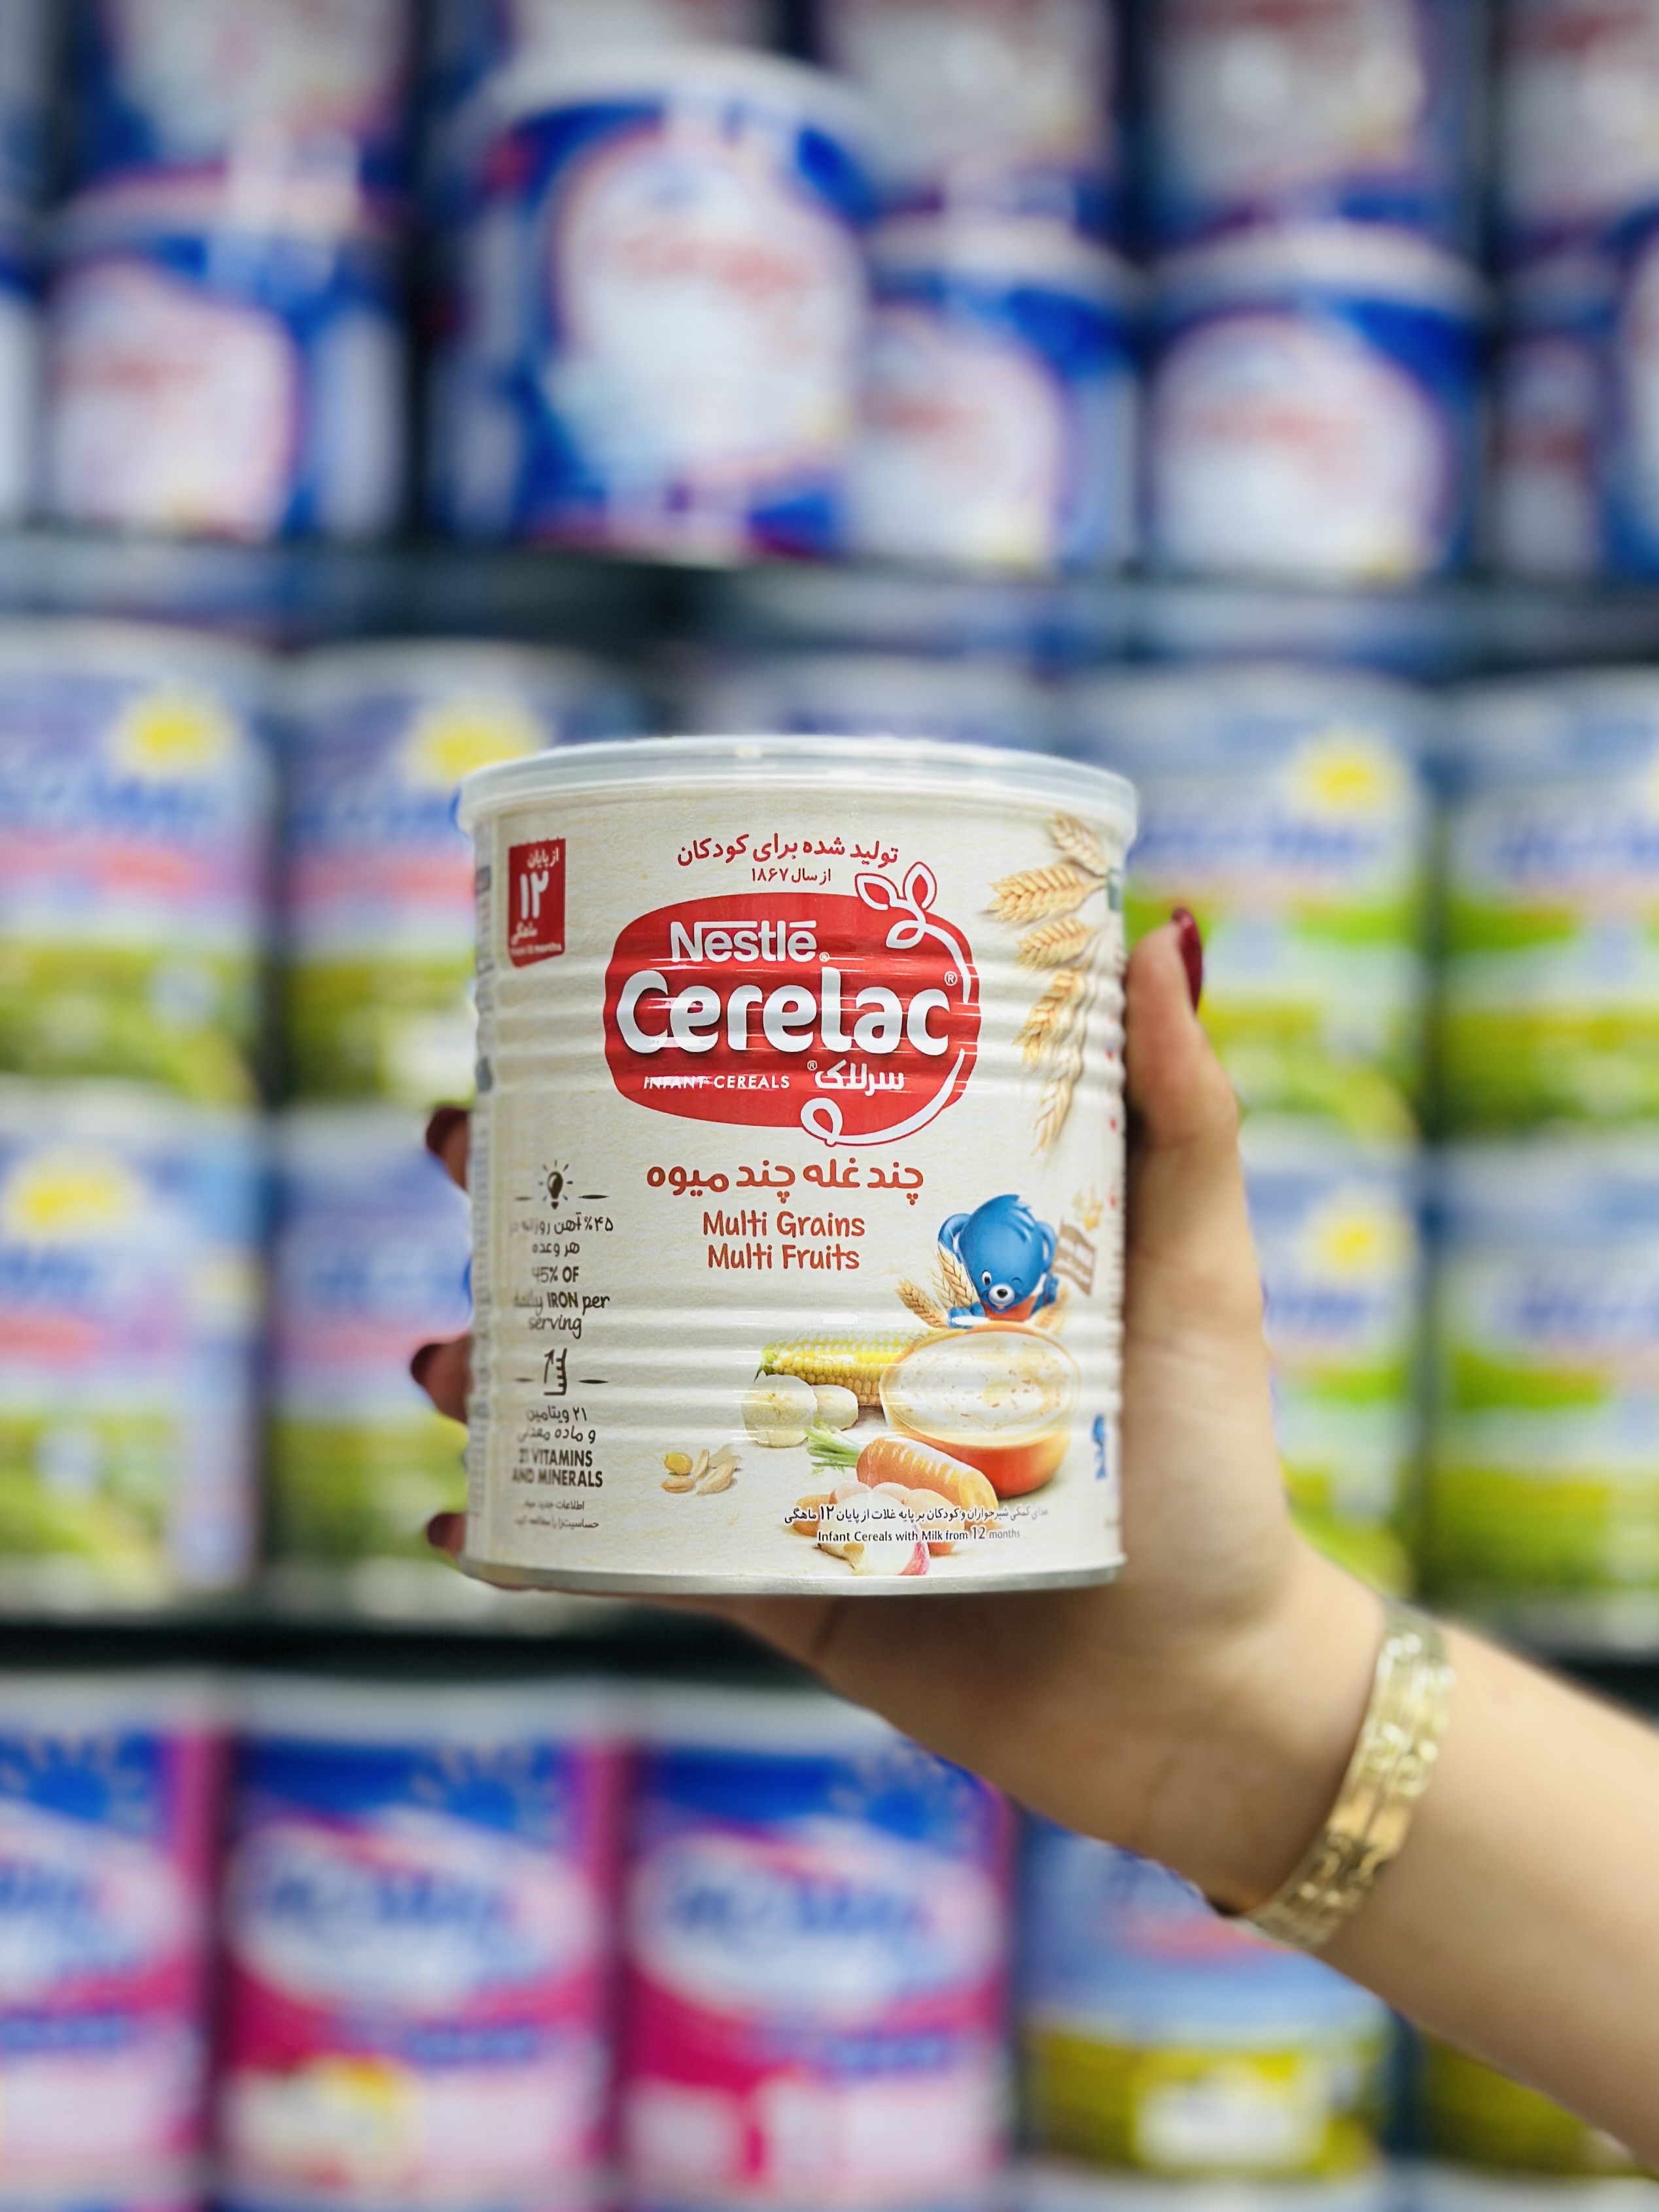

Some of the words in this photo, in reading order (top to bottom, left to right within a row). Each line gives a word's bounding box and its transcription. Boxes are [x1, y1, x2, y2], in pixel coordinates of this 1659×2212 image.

[678, 834, 750, 866] کودکان
[753, 833, 798, 862] برای
[803, 837, 845, 855] شده
[850, 841, 899, 868] تولید
[752, 868, 789, 883] ۱۸۶۷
[792, 868, 818, 883] سال
[819, 868, 831, 885] از
[519, 870, 550, 920] ۱۲
[616, 966, 951, 1056] Cerelac
[643, 1076, 707, 1089] INFANT
[713, 1075, 790, 1089] CEREALS
[646, 1166, 729, 1196] میوه
[736, 1160, 796, 1203] چند
[803, 1157, 860, 1189] غله
[867, 1161, 924, 1205] چند
[554, 1212, 582, 1235] آهن
[703, 1210, 767, 1237] Multi
[777, 1210, 865, 1238] Grains
[532, 1243, 561, 1257] وعده
[564, 1242, 580, 1257] هر
[708, 1242, 772, 1270] Multi
[782, 1243, 860, 1271] Fruits
[562, 1265, 580, 1283] OF
[547, 1291, 579, 1308] IRON
[582, 1294, 610, 1316] per
[527, 1314, 582, 1340] serving
[554, 1424, 584, 1442] ماده
[588, 1429, 596, 1445] و
[531, 1448, 593, 1467] VITAMINS
[512, 1467, 535, 1484] AND
[537, 1468, 603, 1488] MINERALS
[784, 1507, 816, 1524] ماهگی
[820, 1505, 835, 1520] ۱۲
[837, 1507, 860, 1524] پایان
[860, 1508, 870, 1523] از
[871, 1508, 896, 1520] غلات
[927, 1507, 960, 1522] کودکان
[818, 1531, 850, 1542] Infant
[854, 1530, 892, 1542] Cereals
[896, 1530, 918, 1541] with
[922, 1530, 943, 1541] Milk
[946, 1530, 968, 1540] from
[971, 1526, 985, 1539] 12
[988, 1528, 1021, 1539] months
